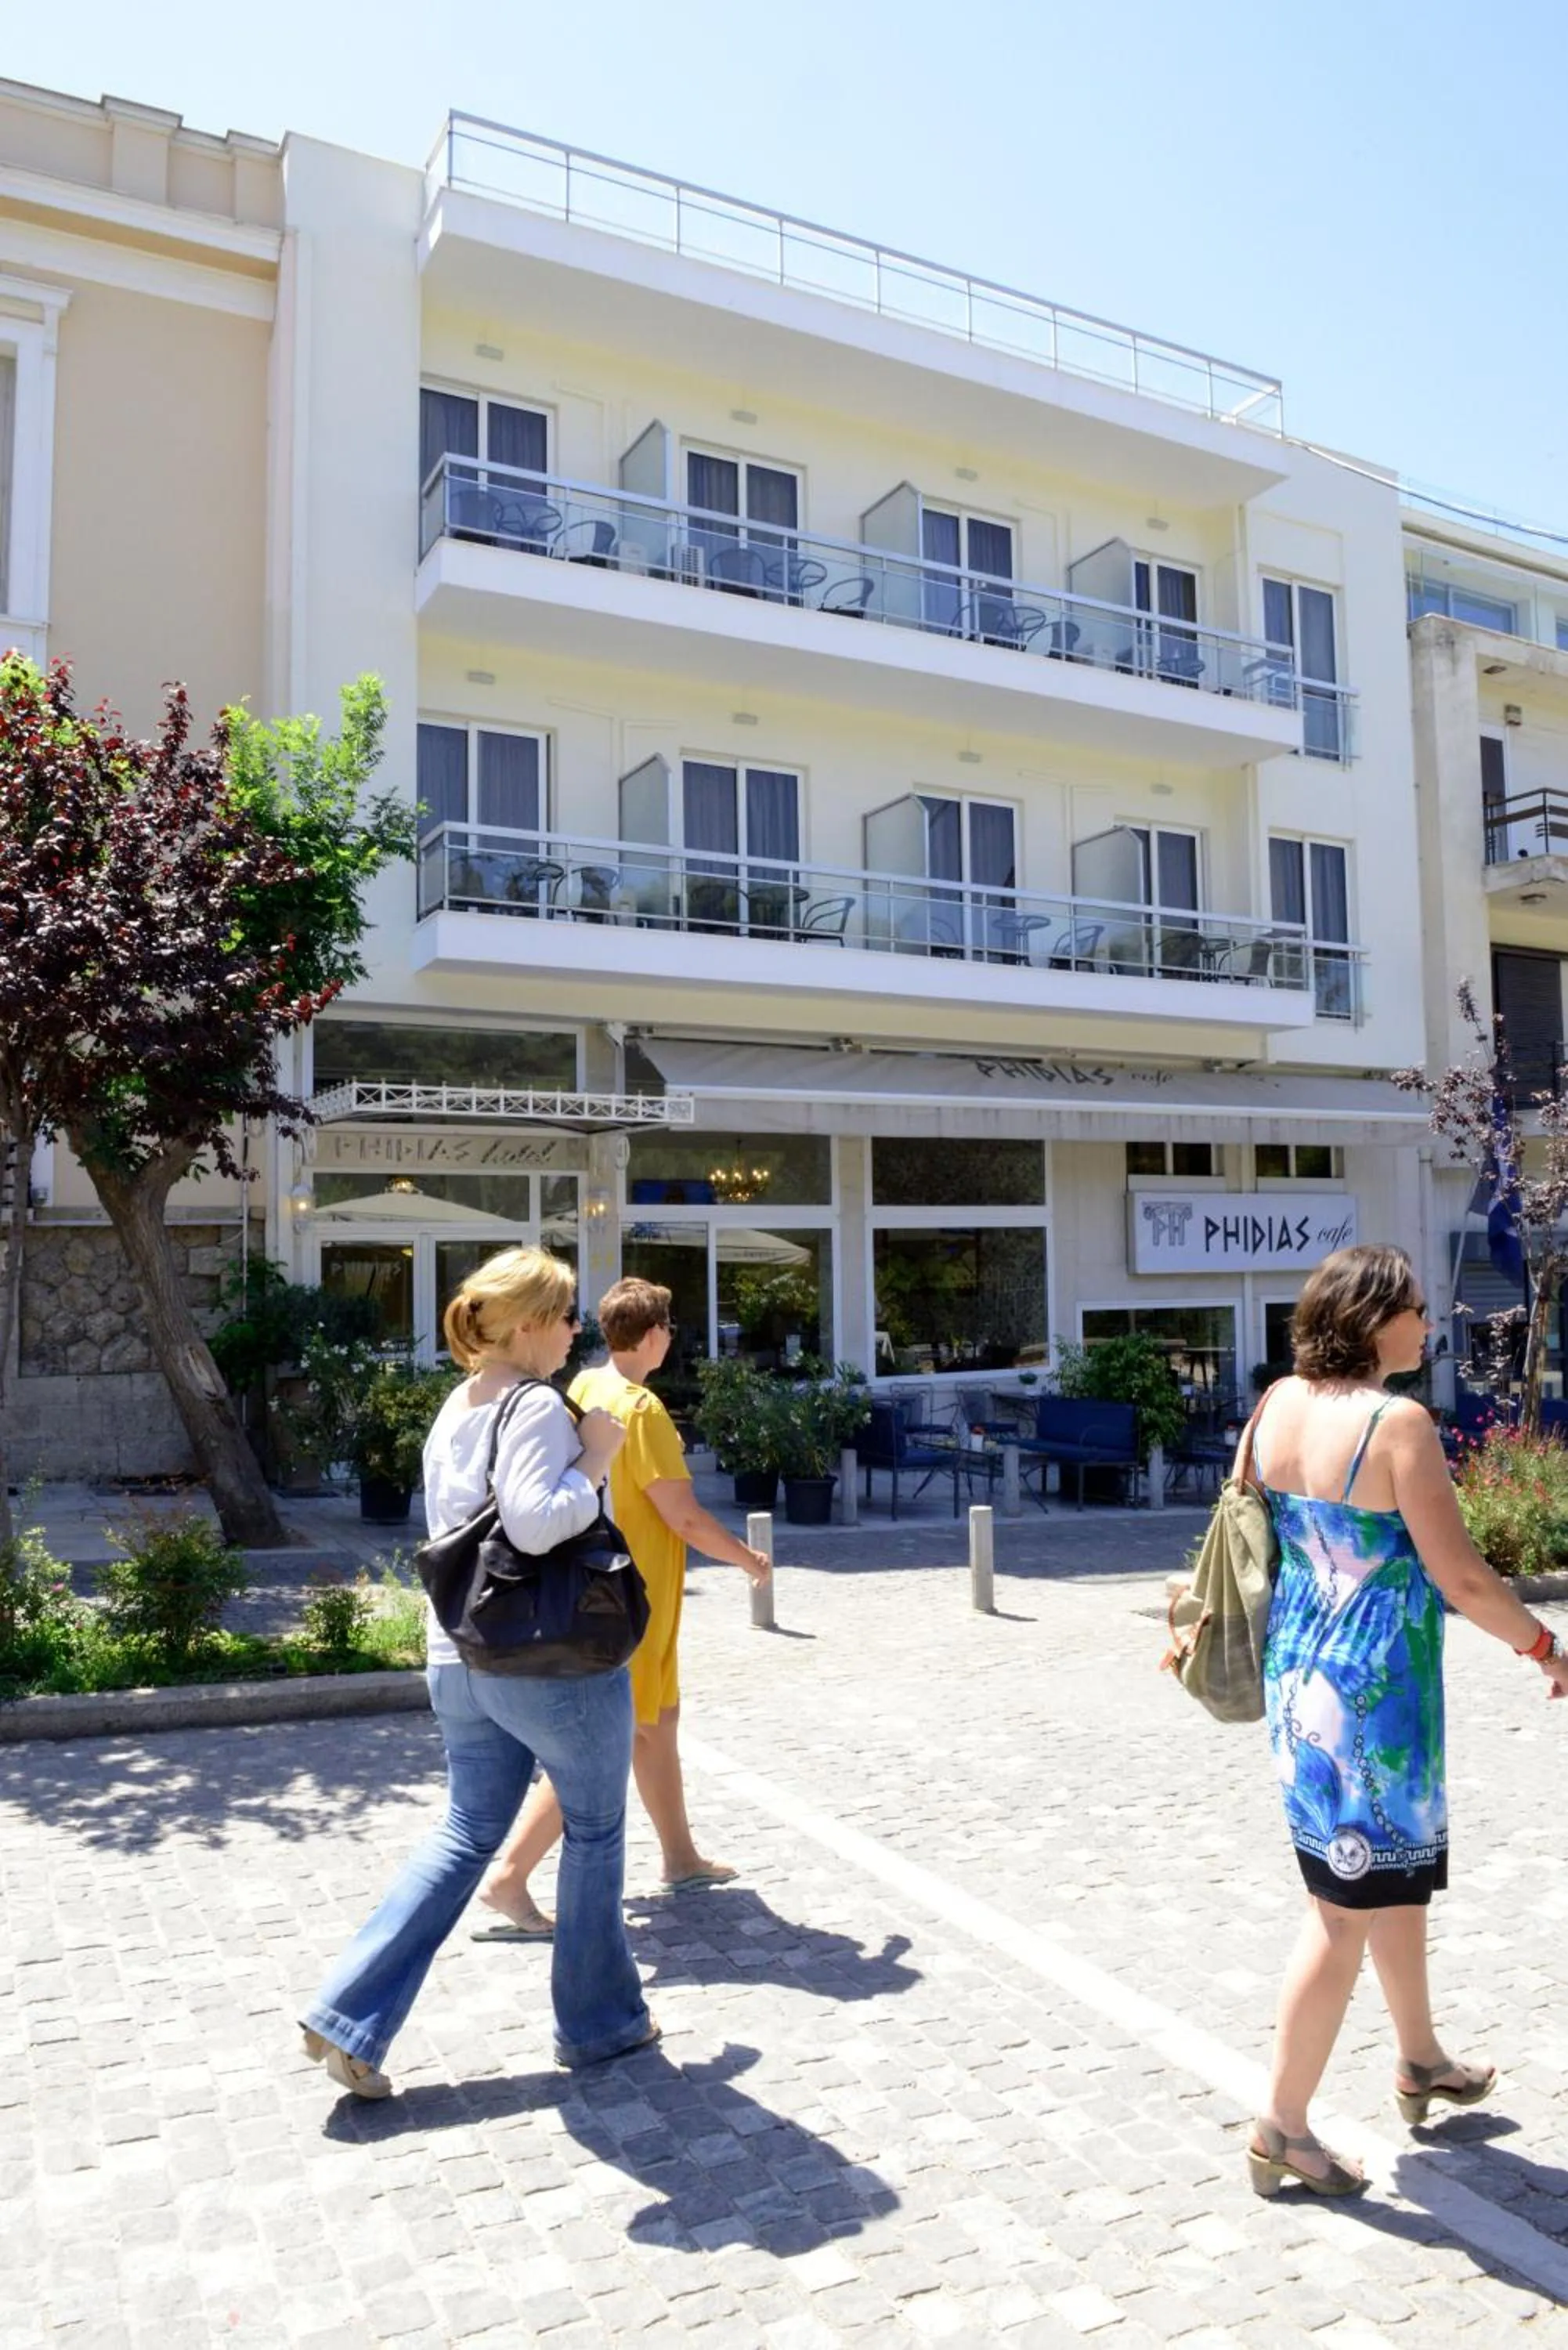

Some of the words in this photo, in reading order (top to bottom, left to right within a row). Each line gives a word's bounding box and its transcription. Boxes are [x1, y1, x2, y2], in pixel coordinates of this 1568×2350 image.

[975, 1060, 1115, 1086] PHIDIAS
[335, 1135, 471, 1162] PHIDIAS
[480, 1139, 558, 1165] hotel
[1204, 1215, 1311, 1254] PHIDIAS
[1317, 1213, 1354, 1252] cafe
